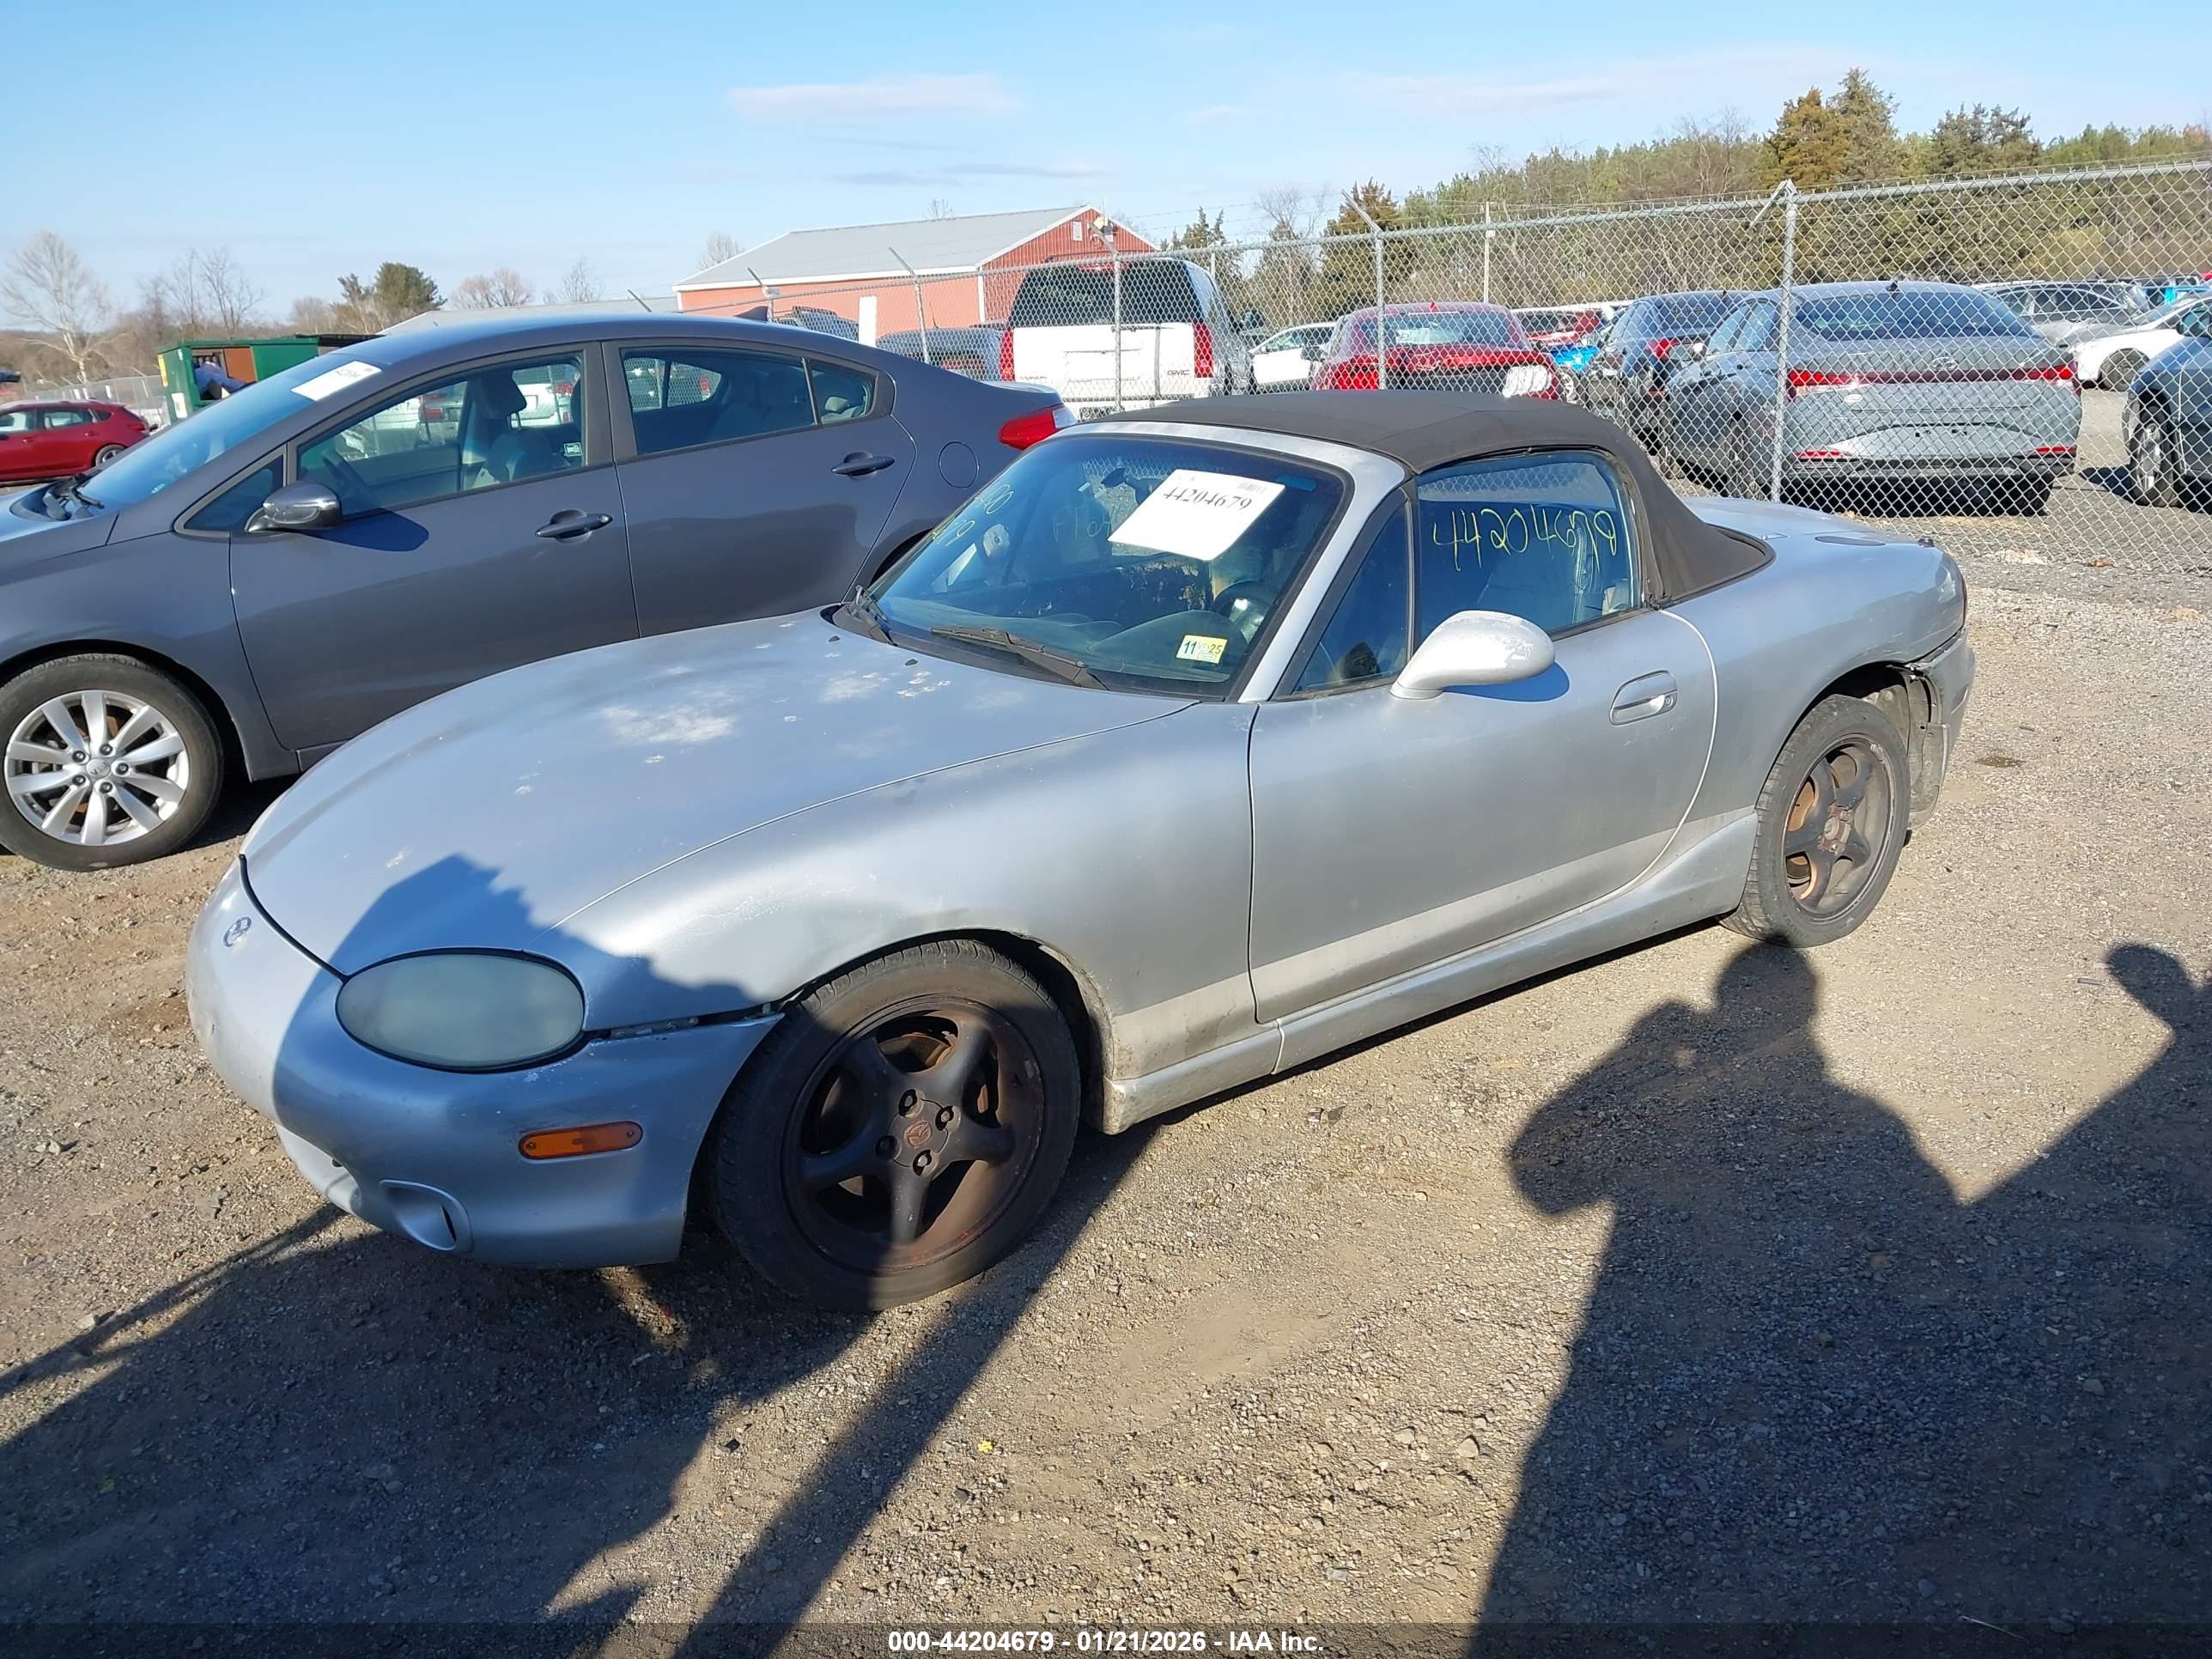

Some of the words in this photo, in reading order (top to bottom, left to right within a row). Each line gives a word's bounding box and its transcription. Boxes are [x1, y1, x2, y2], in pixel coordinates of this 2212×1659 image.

[1164, 487, 1252, 510] 44204679
[1432, 503, 1618, 571] 44204679
[1184, 640, 1197, 654] 11
[1209, 644, 1223, 653] 25
